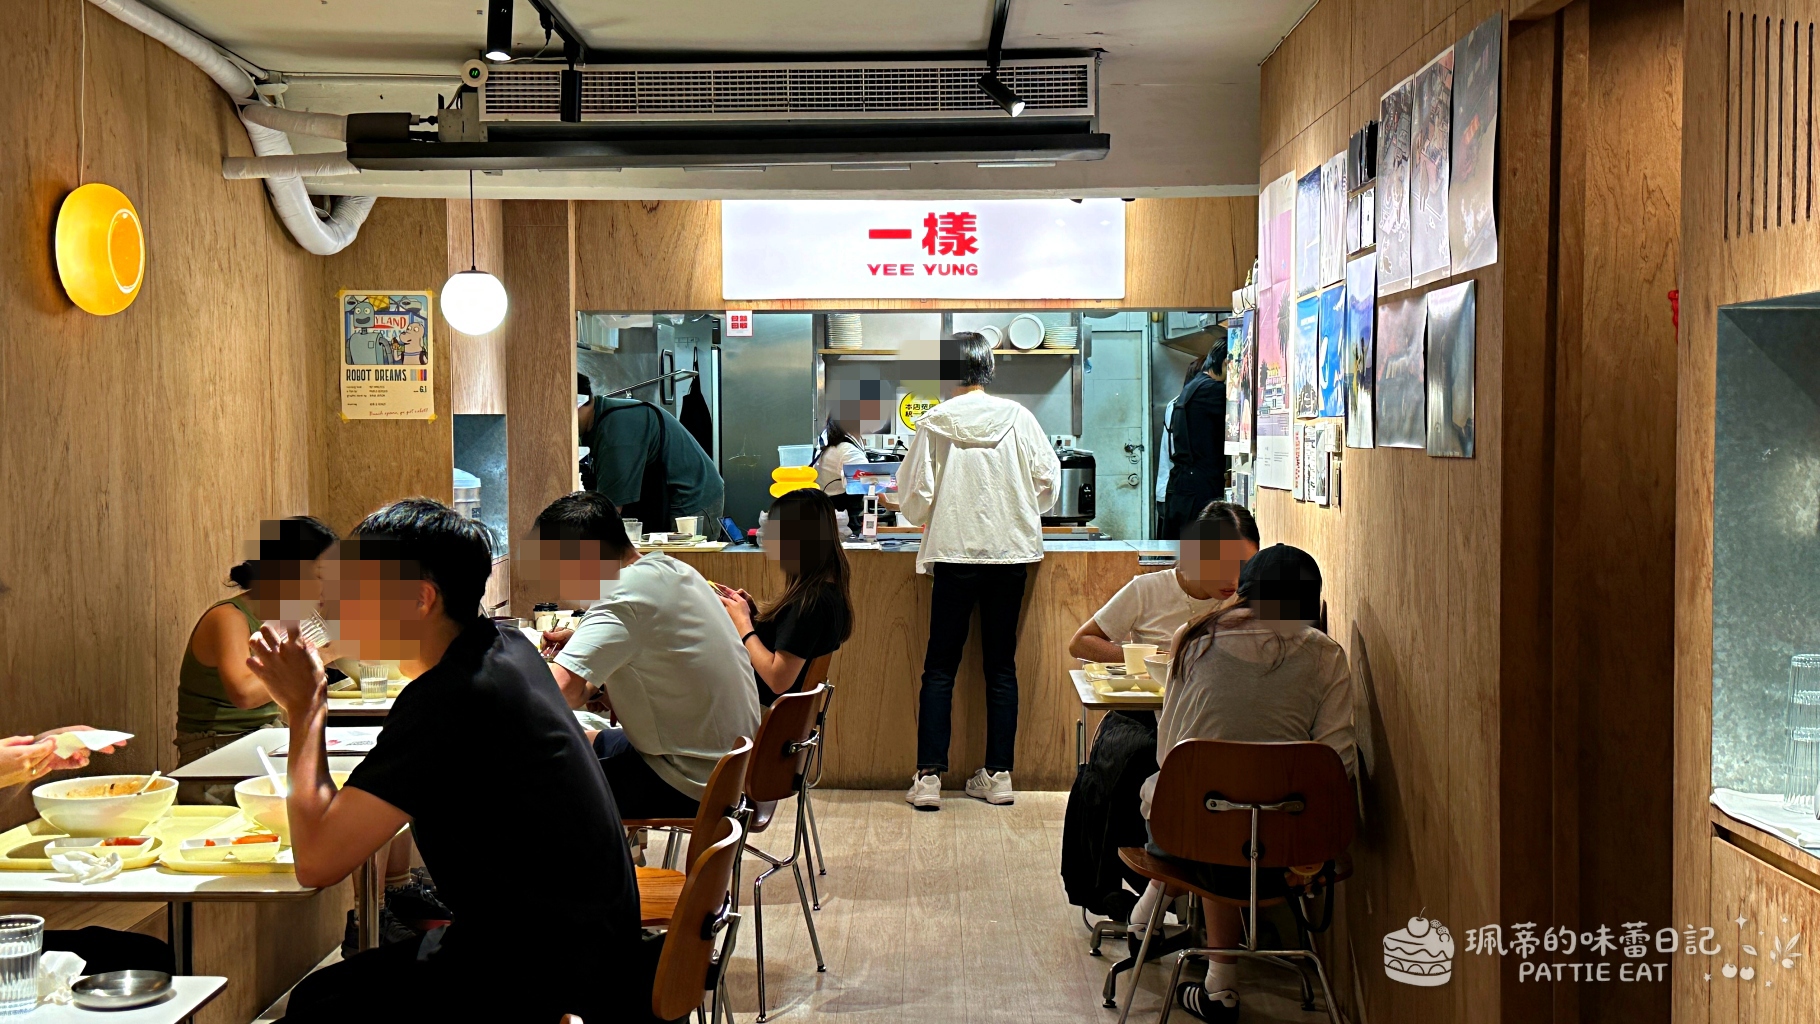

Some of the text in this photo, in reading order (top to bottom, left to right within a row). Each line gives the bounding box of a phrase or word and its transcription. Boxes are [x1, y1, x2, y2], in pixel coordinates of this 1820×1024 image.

[868, 211, 979, 256] 一樣
[867, 263, 978, 276] YEE YUNG
[346, 369, 407, 381] ROBOT DREAMS
